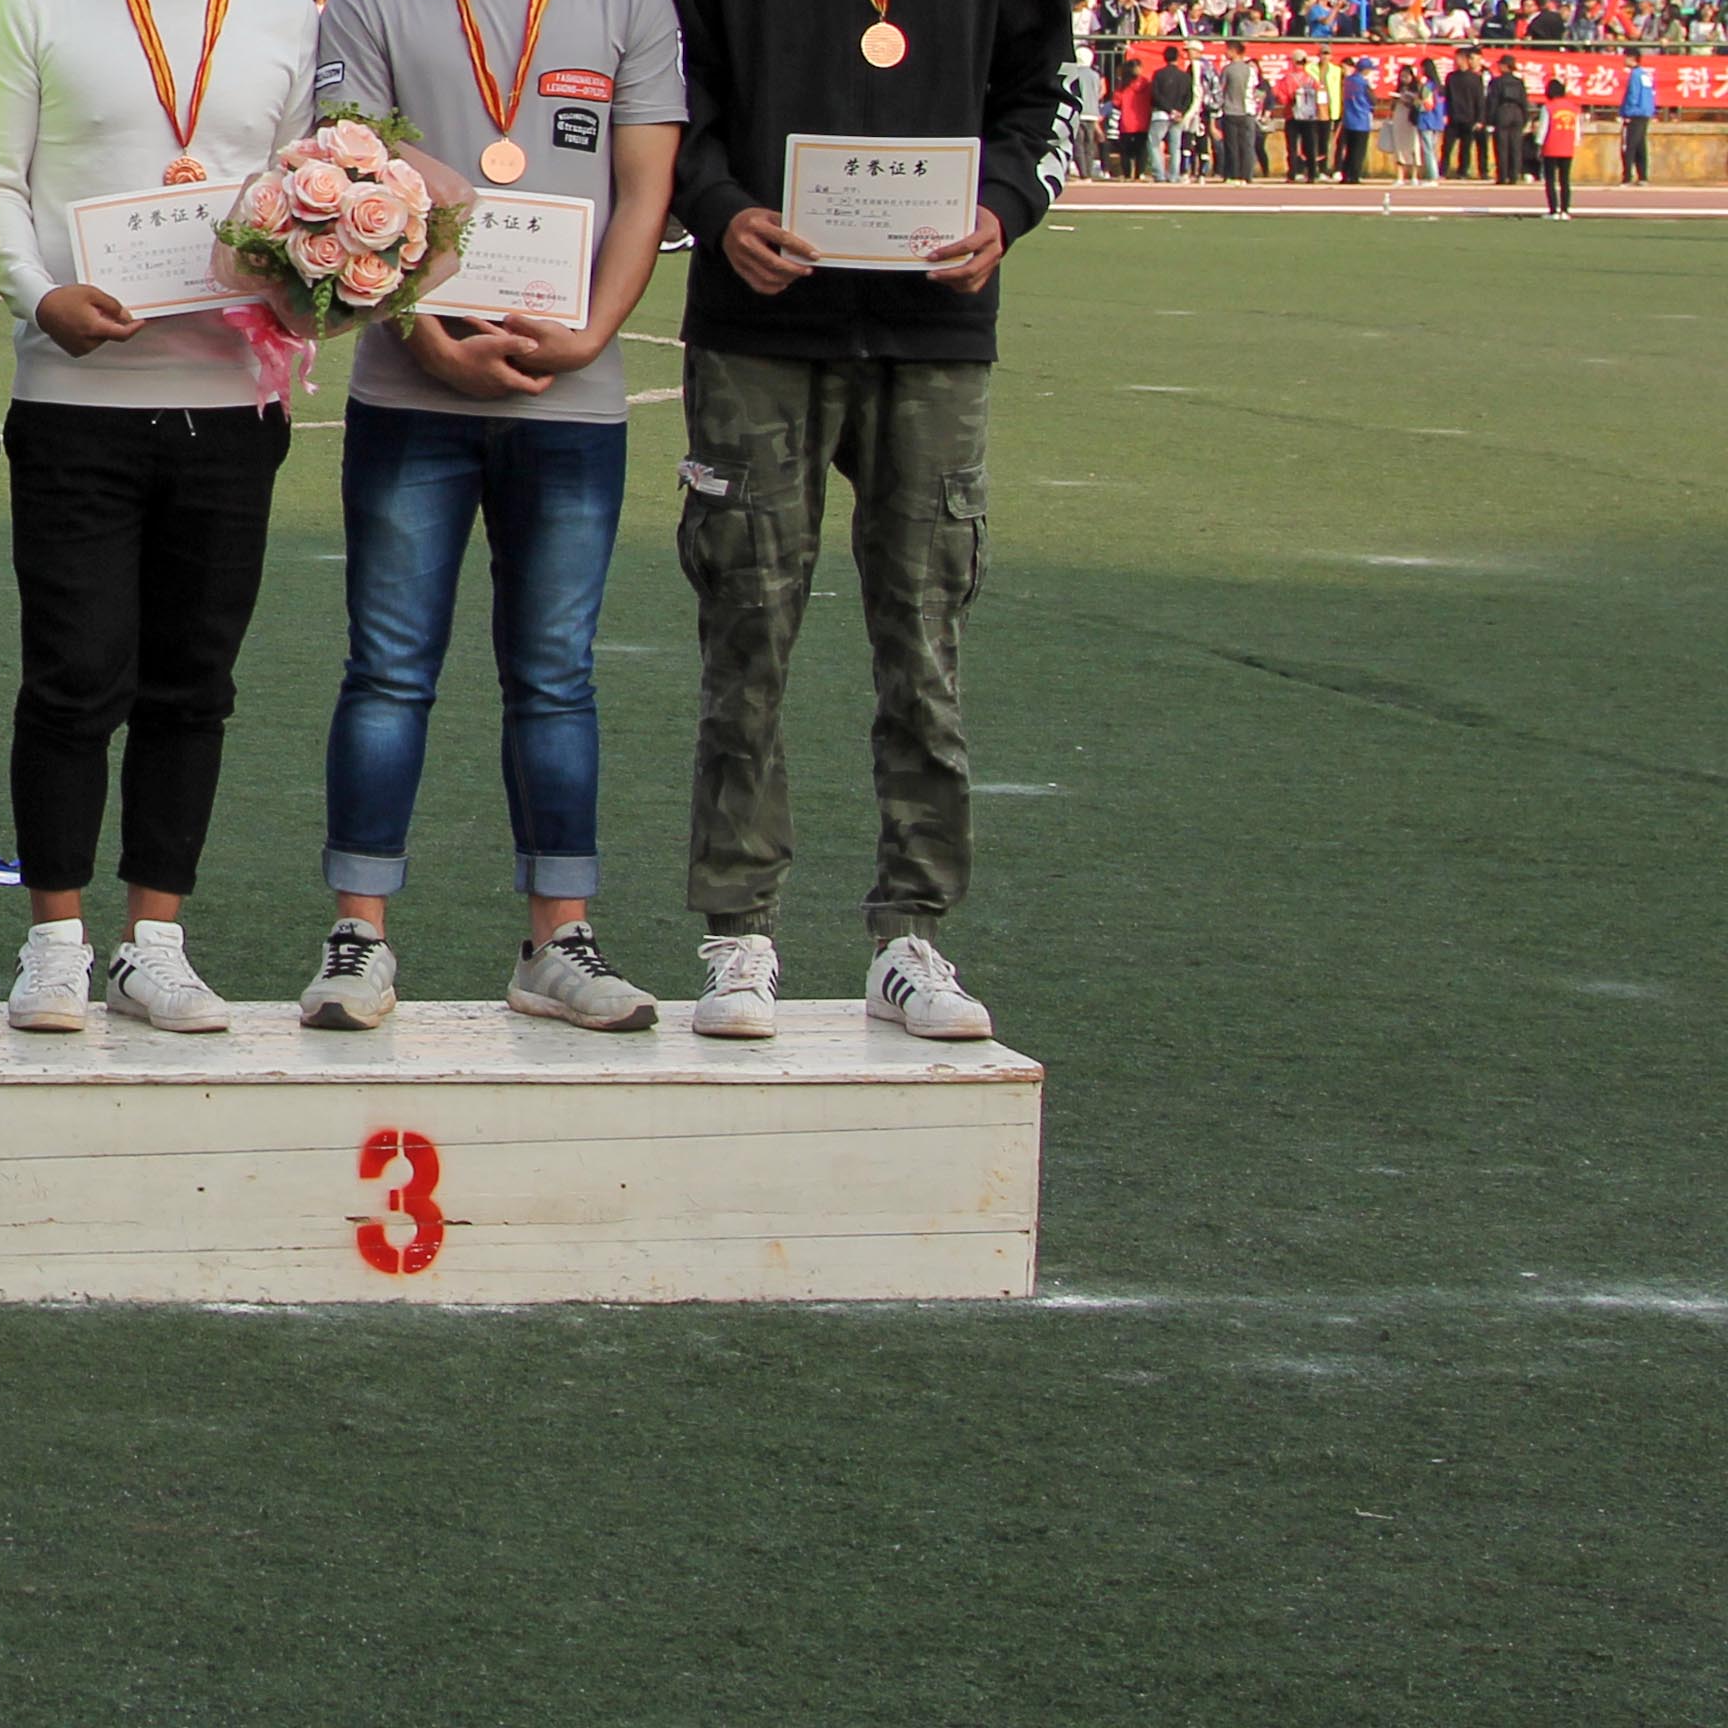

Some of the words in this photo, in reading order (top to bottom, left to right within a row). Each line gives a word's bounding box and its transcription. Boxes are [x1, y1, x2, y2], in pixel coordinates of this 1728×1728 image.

[843, 157, 929, 177] 荣誉证书
[126, 203, 210, 230] 荣誉证书
[482, 211, 543, 233] 誉证书
[356, 1128, 445, 1275] 3
